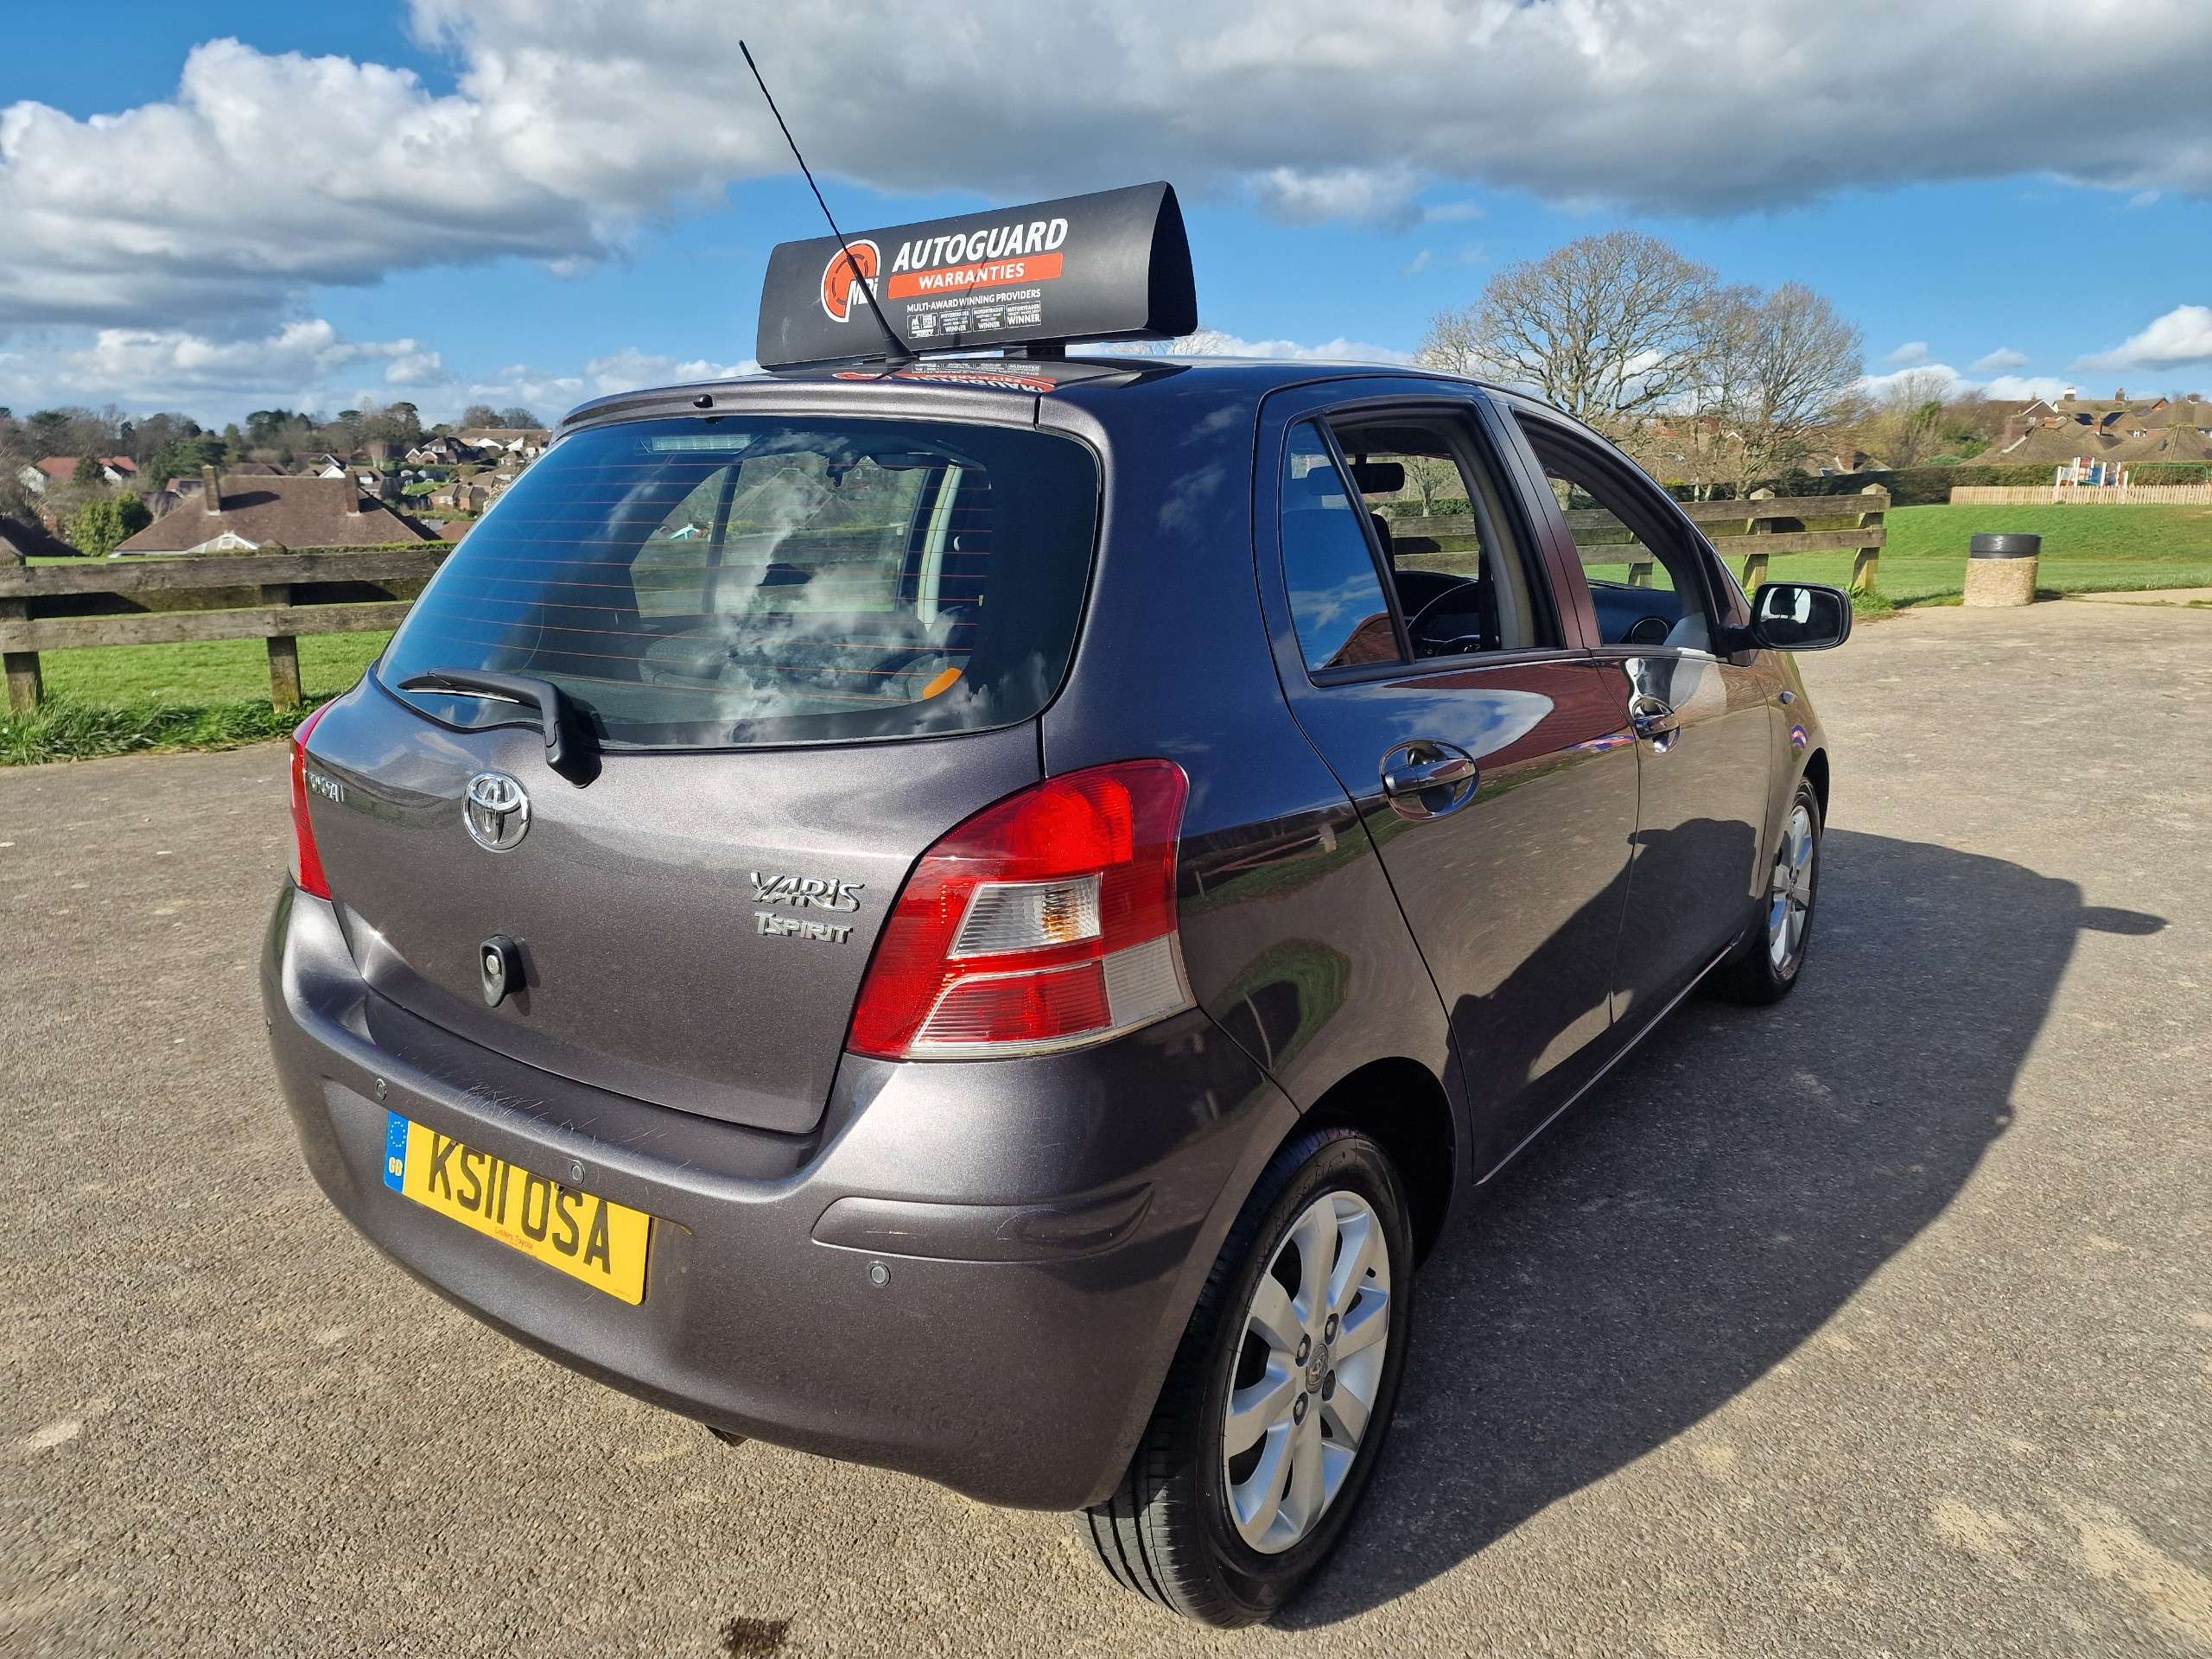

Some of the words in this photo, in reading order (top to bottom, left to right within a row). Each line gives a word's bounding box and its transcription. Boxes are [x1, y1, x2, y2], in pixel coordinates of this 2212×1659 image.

[891, 218, 1069, 273] AUTOGUARD
[918, 263, 1025, 290] WARRANTIES
[906, 298, 958, 313] MULTI-AWARD
[958, 294, 995, 307] WINNING
[995, 289, 1041, 302] PROVIDERS
[978, 321, 1001, 330] WINNER
[1007, 314, 1040, 325] WINNER
[389, 1156, 404, 1177] GB
[520, 1172, 611, 1275] OSA
